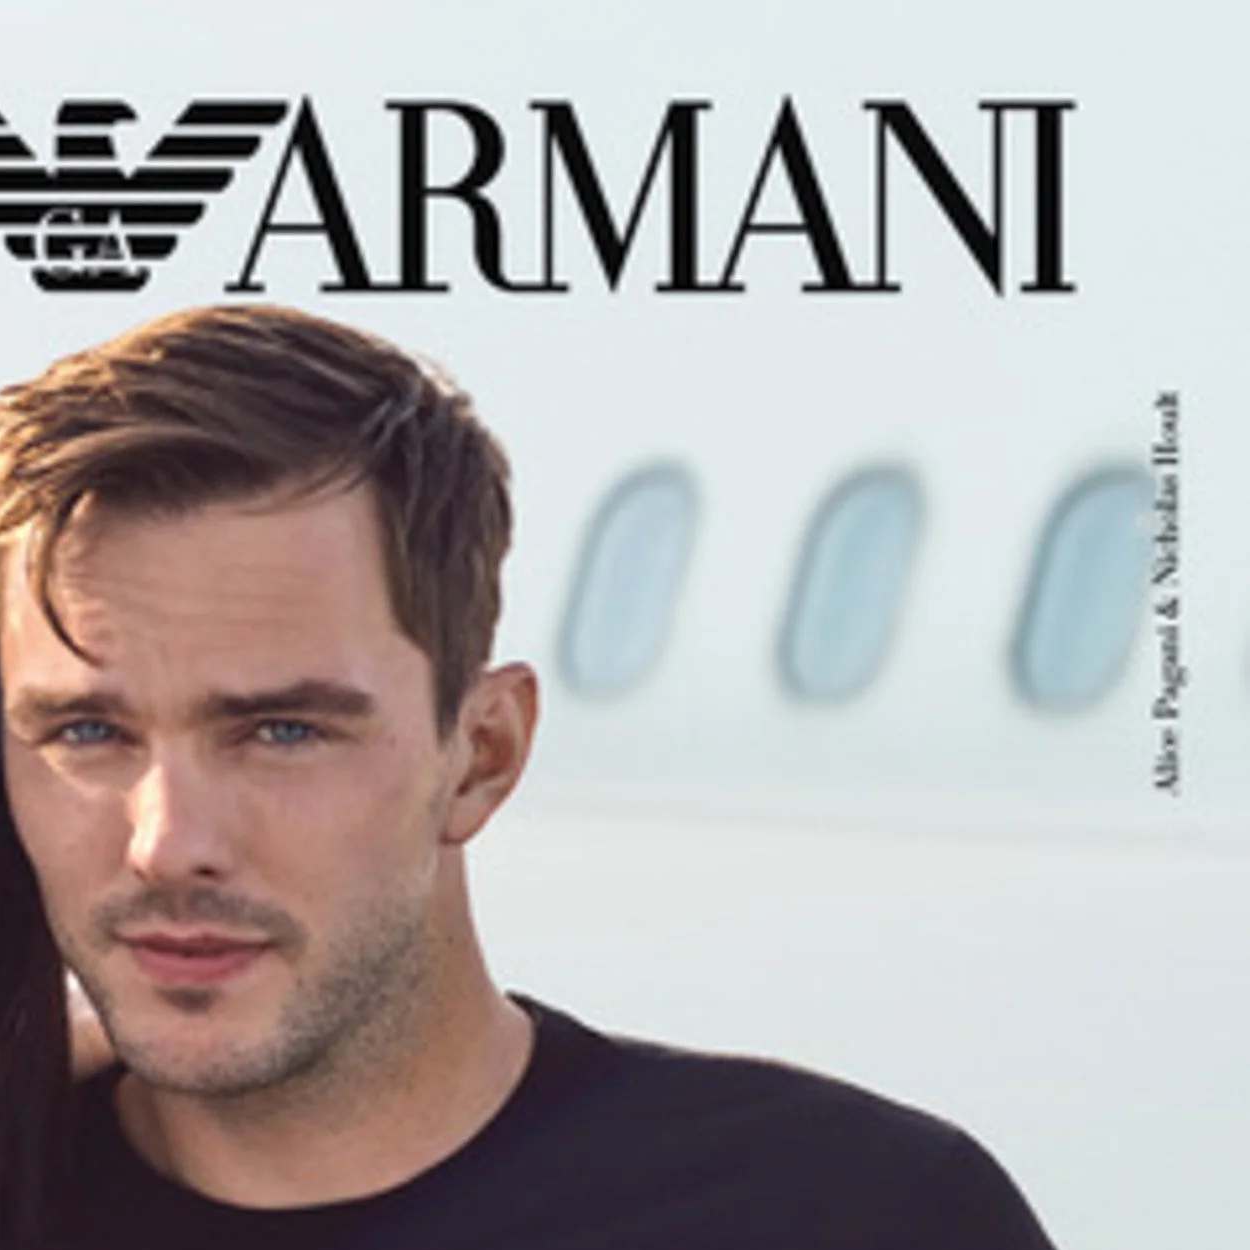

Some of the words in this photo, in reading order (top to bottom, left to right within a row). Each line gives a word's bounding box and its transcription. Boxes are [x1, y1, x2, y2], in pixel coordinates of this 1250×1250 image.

[224, 96, 1077, 297] ARMANI
[1151, 390, 1180, 466] Hoult
[1150, 473, 1180, 586] Nicholas
[1155, 596, 1180, 620] &
[1151, 625, 1188, 720] Pagani
[1153, 727, 1180, 798] Alice
